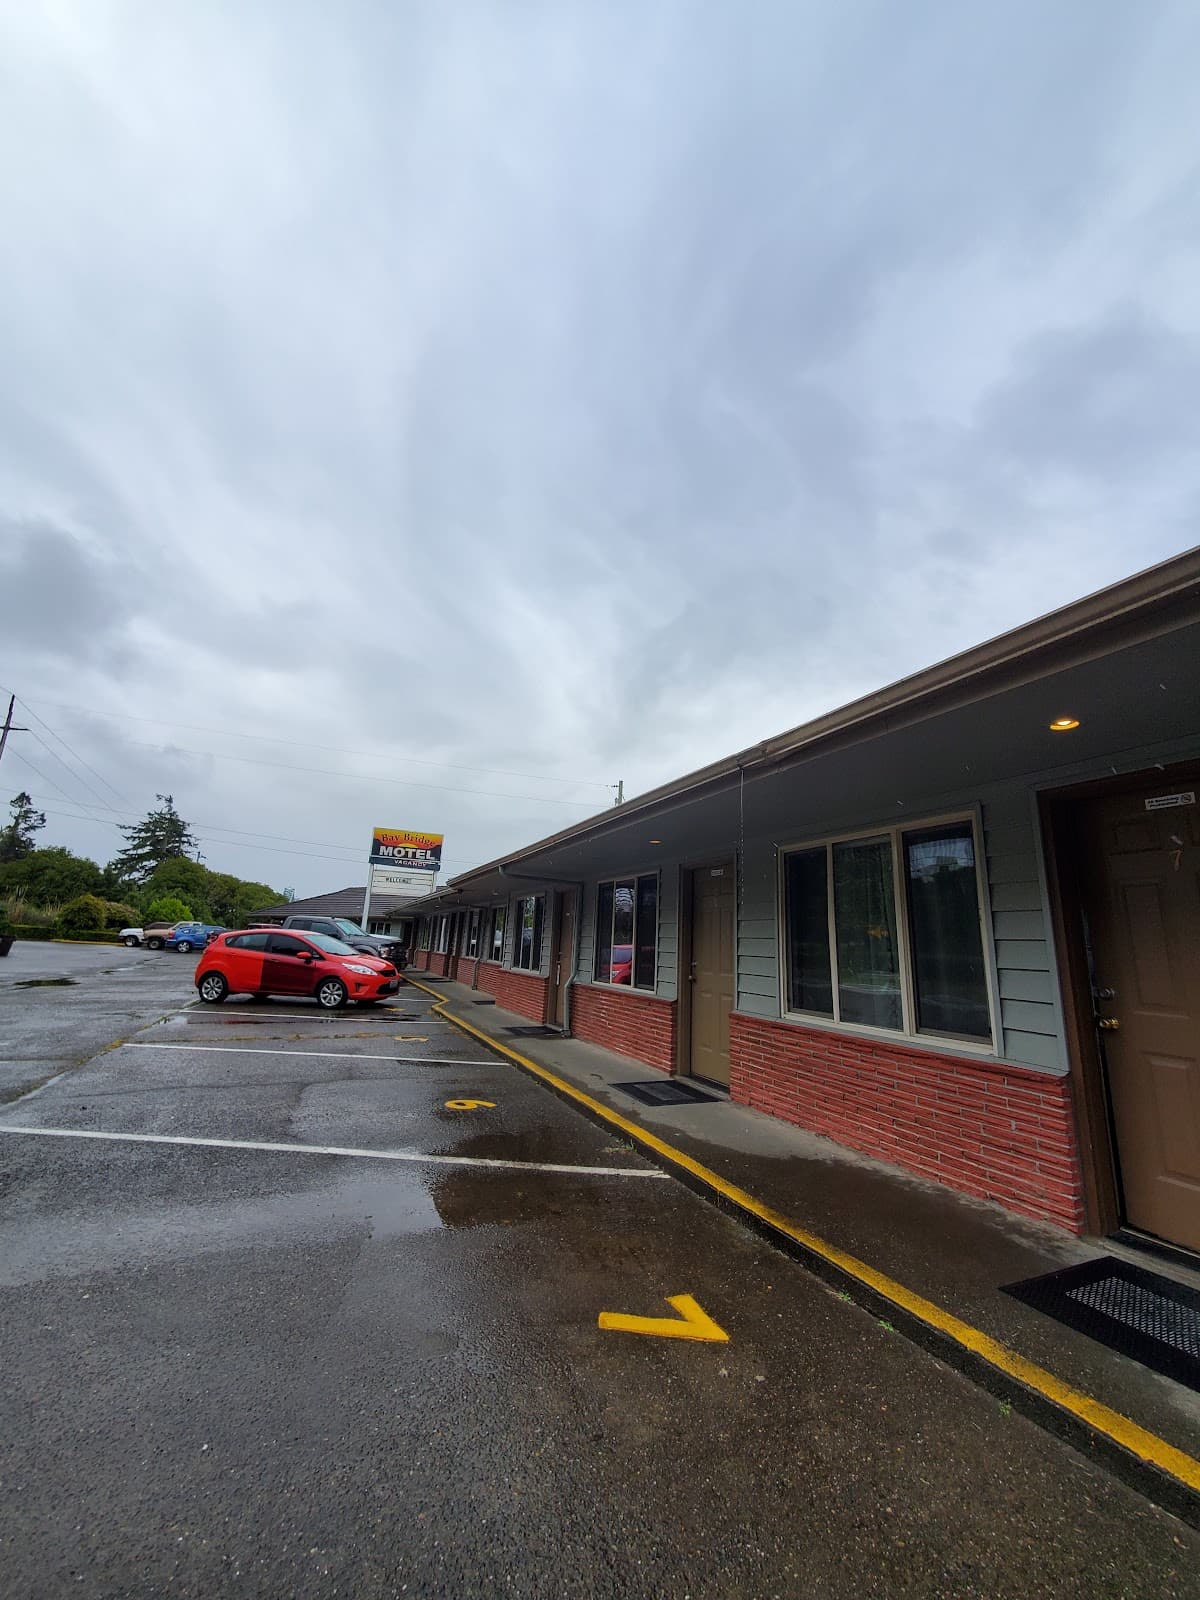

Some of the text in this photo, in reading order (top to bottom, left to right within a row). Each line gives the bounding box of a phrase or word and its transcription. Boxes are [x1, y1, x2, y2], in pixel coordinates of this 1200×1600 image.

[382, 833, 435, 846] Bay Bridge
[379, 846, 435, 859] MOTEL
[598, 1293, 731, 1344] 7
